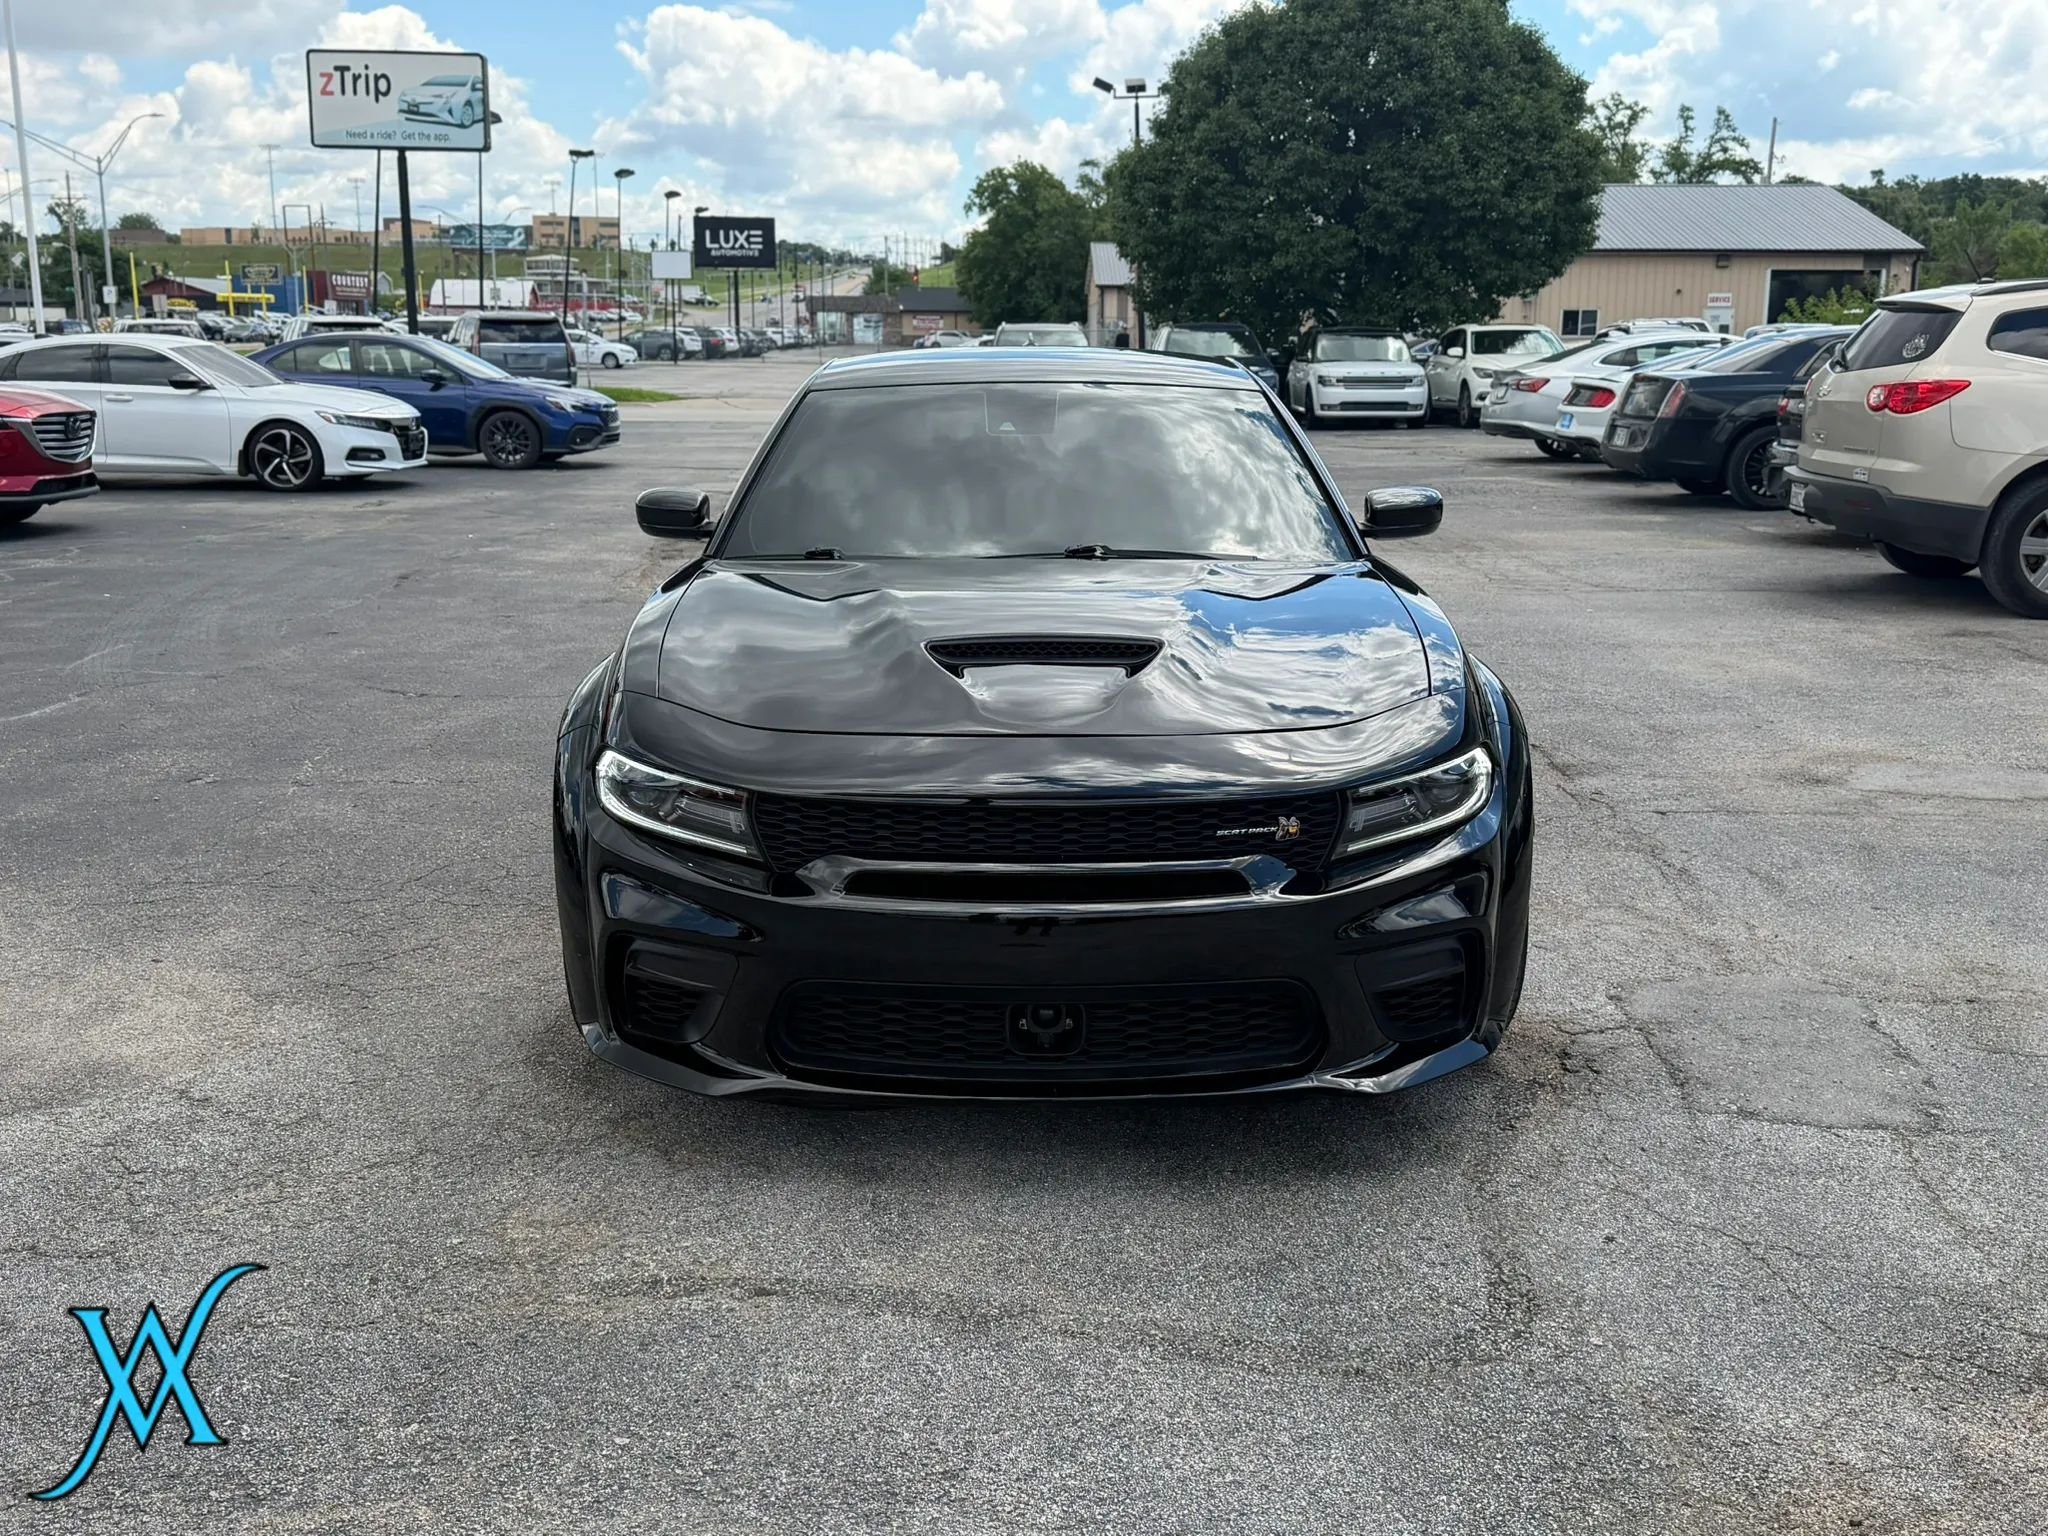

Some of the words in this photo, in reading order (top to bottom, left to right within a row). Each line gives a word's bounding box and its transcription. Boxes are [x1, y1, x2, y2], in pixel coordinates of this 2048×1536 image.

[319, 64, 391, 104] zTrip
[345, 130, 368, 140] Need
[370, 131, 375, 140] a
[376, 130, 397, 141] ride?
[401, 130, 416, 141] Get
[417, 131, 431, 142] the
[434, 132, 451, 143] app.
[705, 229, 763, 249] LUXE
[710, 249, 759, 257] AUTOMOTIVE
[1709, 295, 1731, 304] SERVICE
[1216, 828, 1248, 836] SCAT
[1248, 826, 1279, 834] PACK
